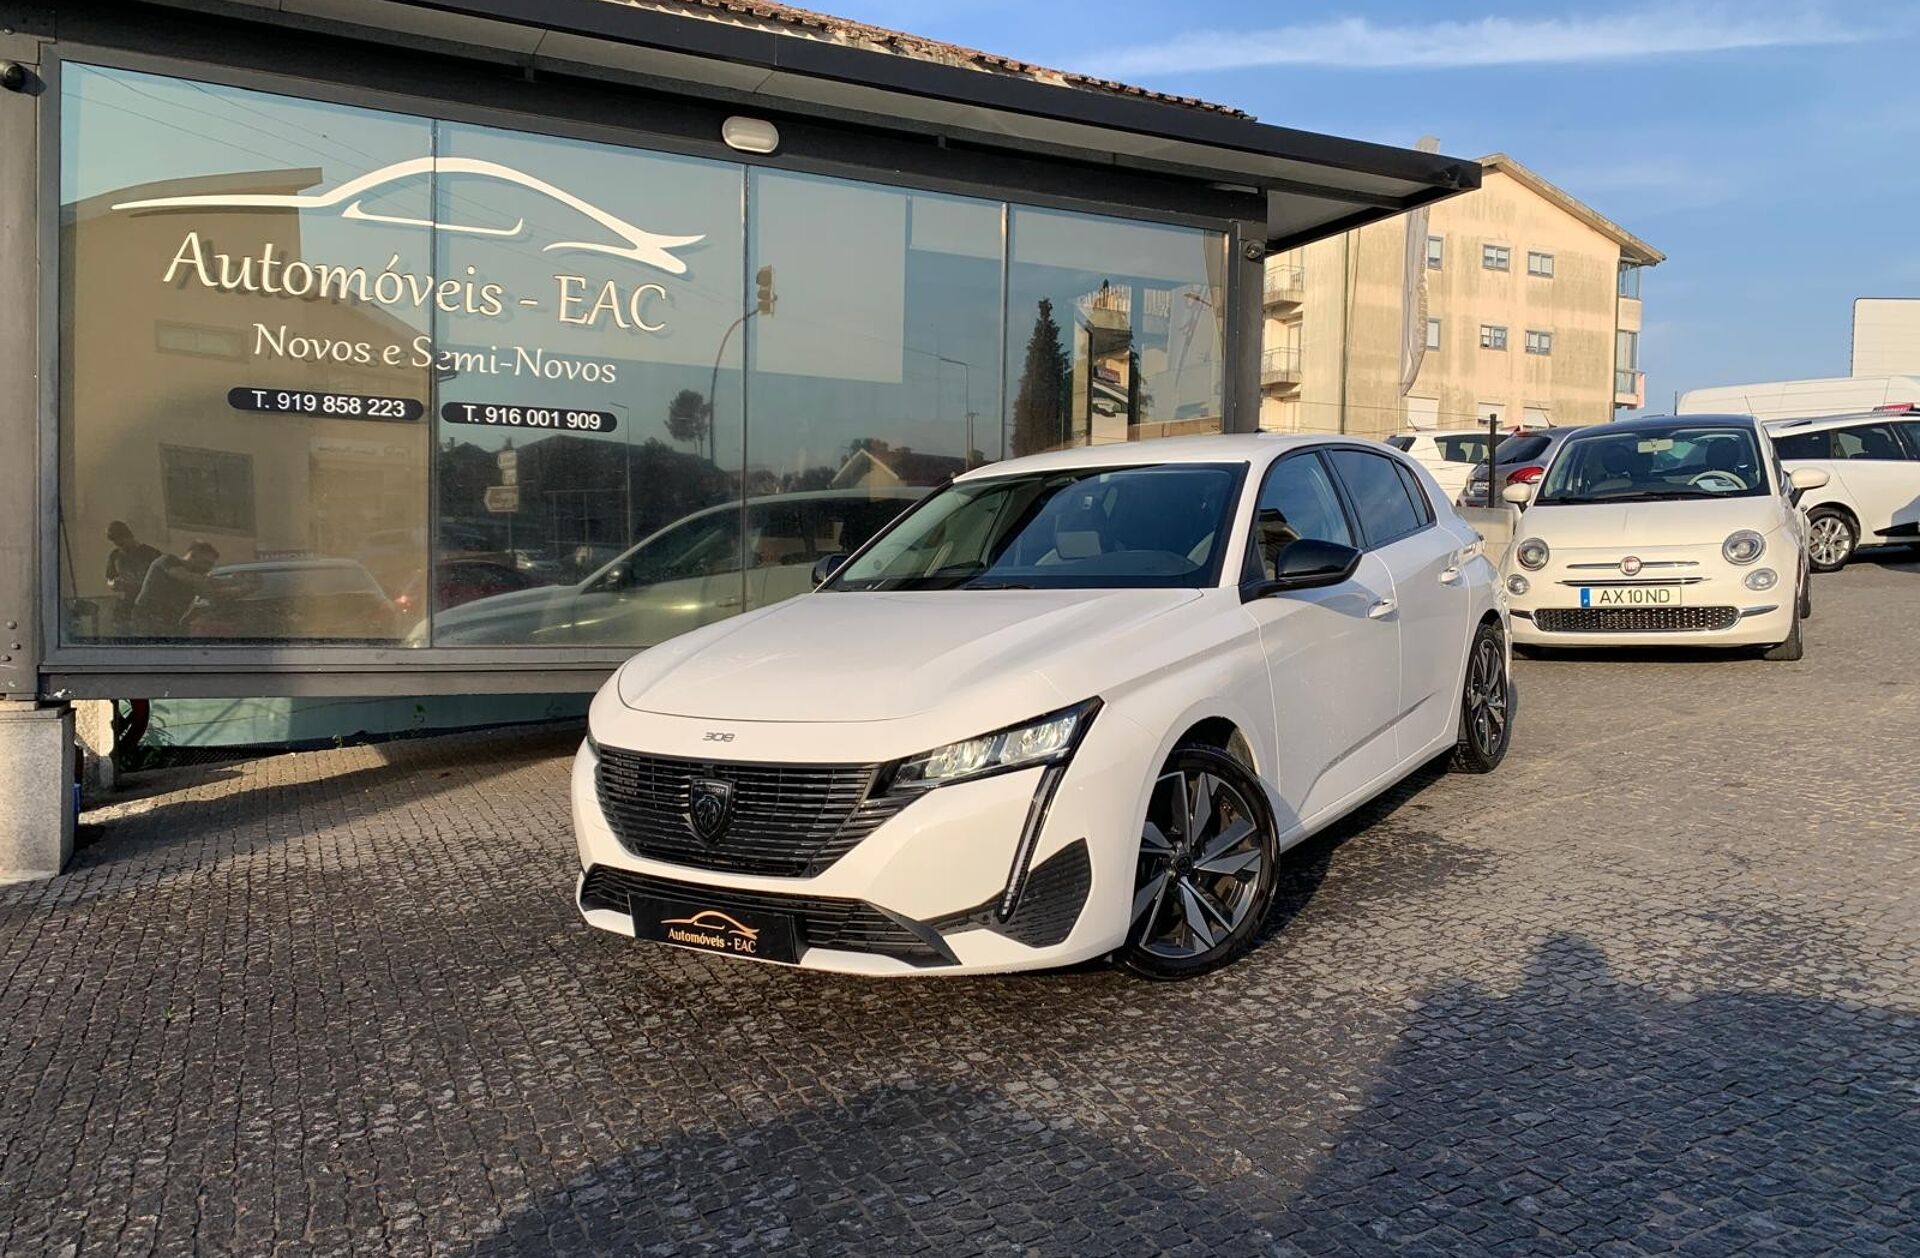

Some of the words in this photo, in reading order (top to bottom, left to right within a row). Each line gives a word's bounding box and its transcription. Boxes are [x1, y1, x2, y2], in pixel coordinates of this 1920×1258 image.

[163, 231, 503, 316] Automóveis
[554, 275, 667, 331] EAC
[253, 323, 371, 363] Novos
[383, 344, 401, 365] e
[251, 391, 270, 409] T.
[277, 392, 317, 411] 919
[322, 396, 362, 414] 858
[367, 399, 406, 417] 223
[462, 405, 479, 422] T.
[485, 407, 521, 424] 916
[526, 408, 560, 427] 001
[566, 412, 601, 429] 909
[702, 731, 735, 742] 308
[668, 928, 725, 948] Automóveis
[734, 938, 757, 953] EAC
